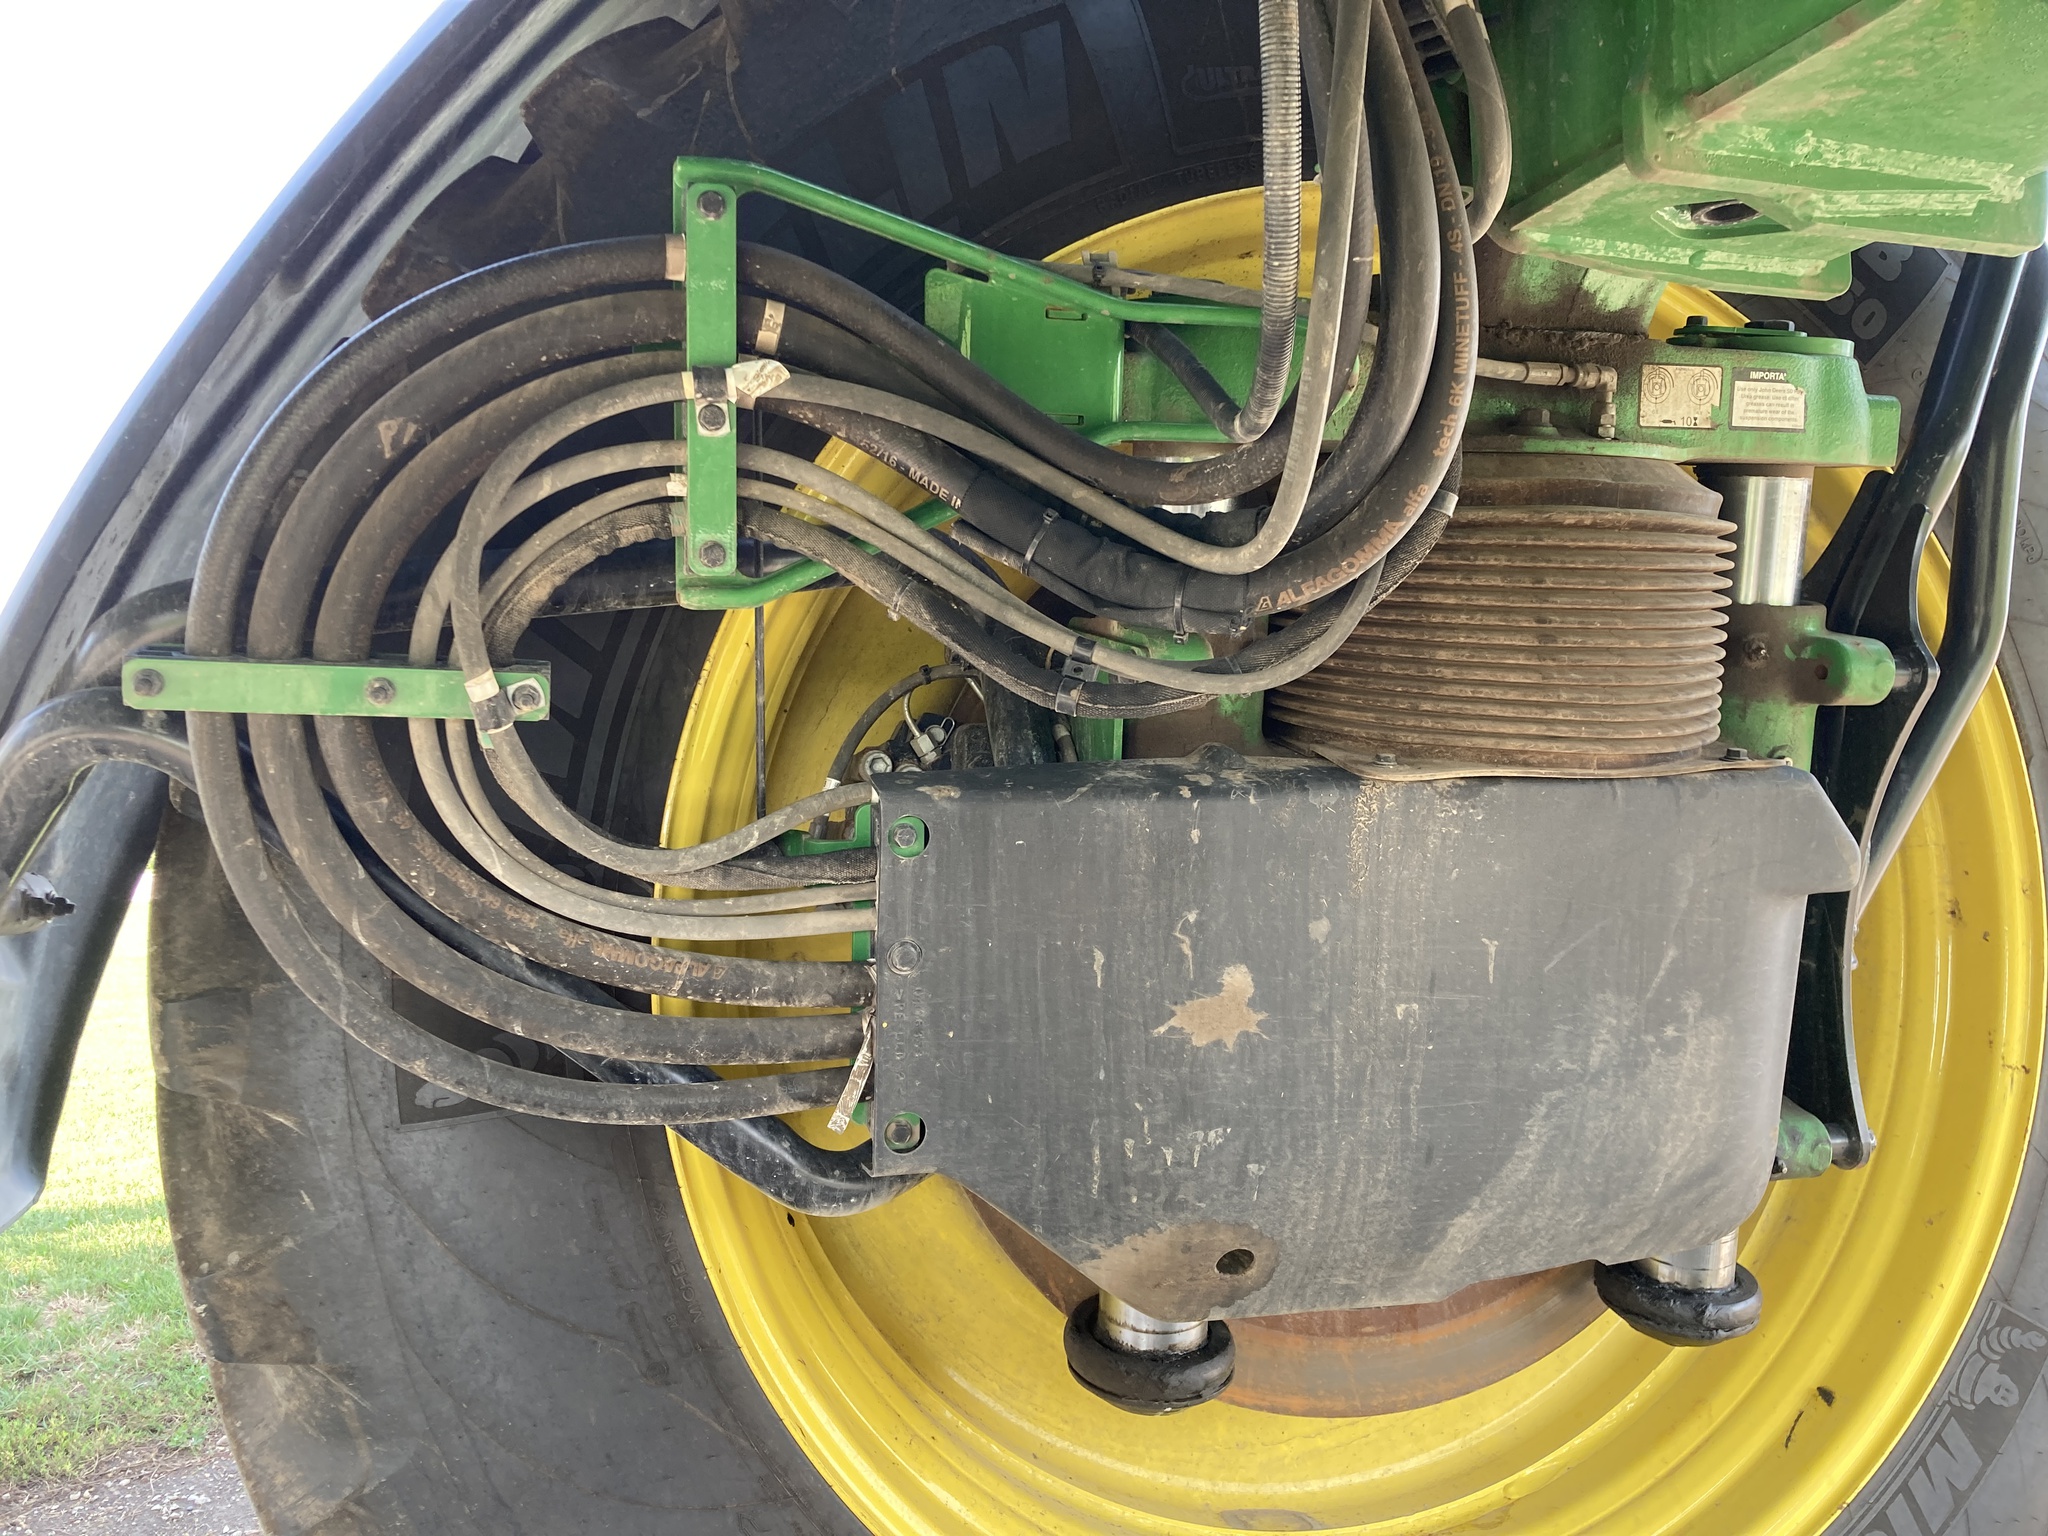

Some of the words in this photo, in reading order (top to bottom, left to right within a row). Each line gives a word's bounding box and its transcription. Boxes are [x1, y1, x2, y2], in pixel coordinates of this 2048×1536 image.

[1436, 182, 1456, 212] DN
[1452, 272, 1470, 376] MINETUFF
[1449, 380, 1465, 407] 6K
[1750, 371, 1787, 381] IMPORTA
[1432, 413, 1457, 458] tech
[1681, 416, 1692, 426] 10
[908, 466, 950, 501] MADE
[1403, 482, 1429, 518] alfa
[1276, 520, 1406, 608] ALFAGOMMA
[661, 1231, 705, 1324] MICHELIN
